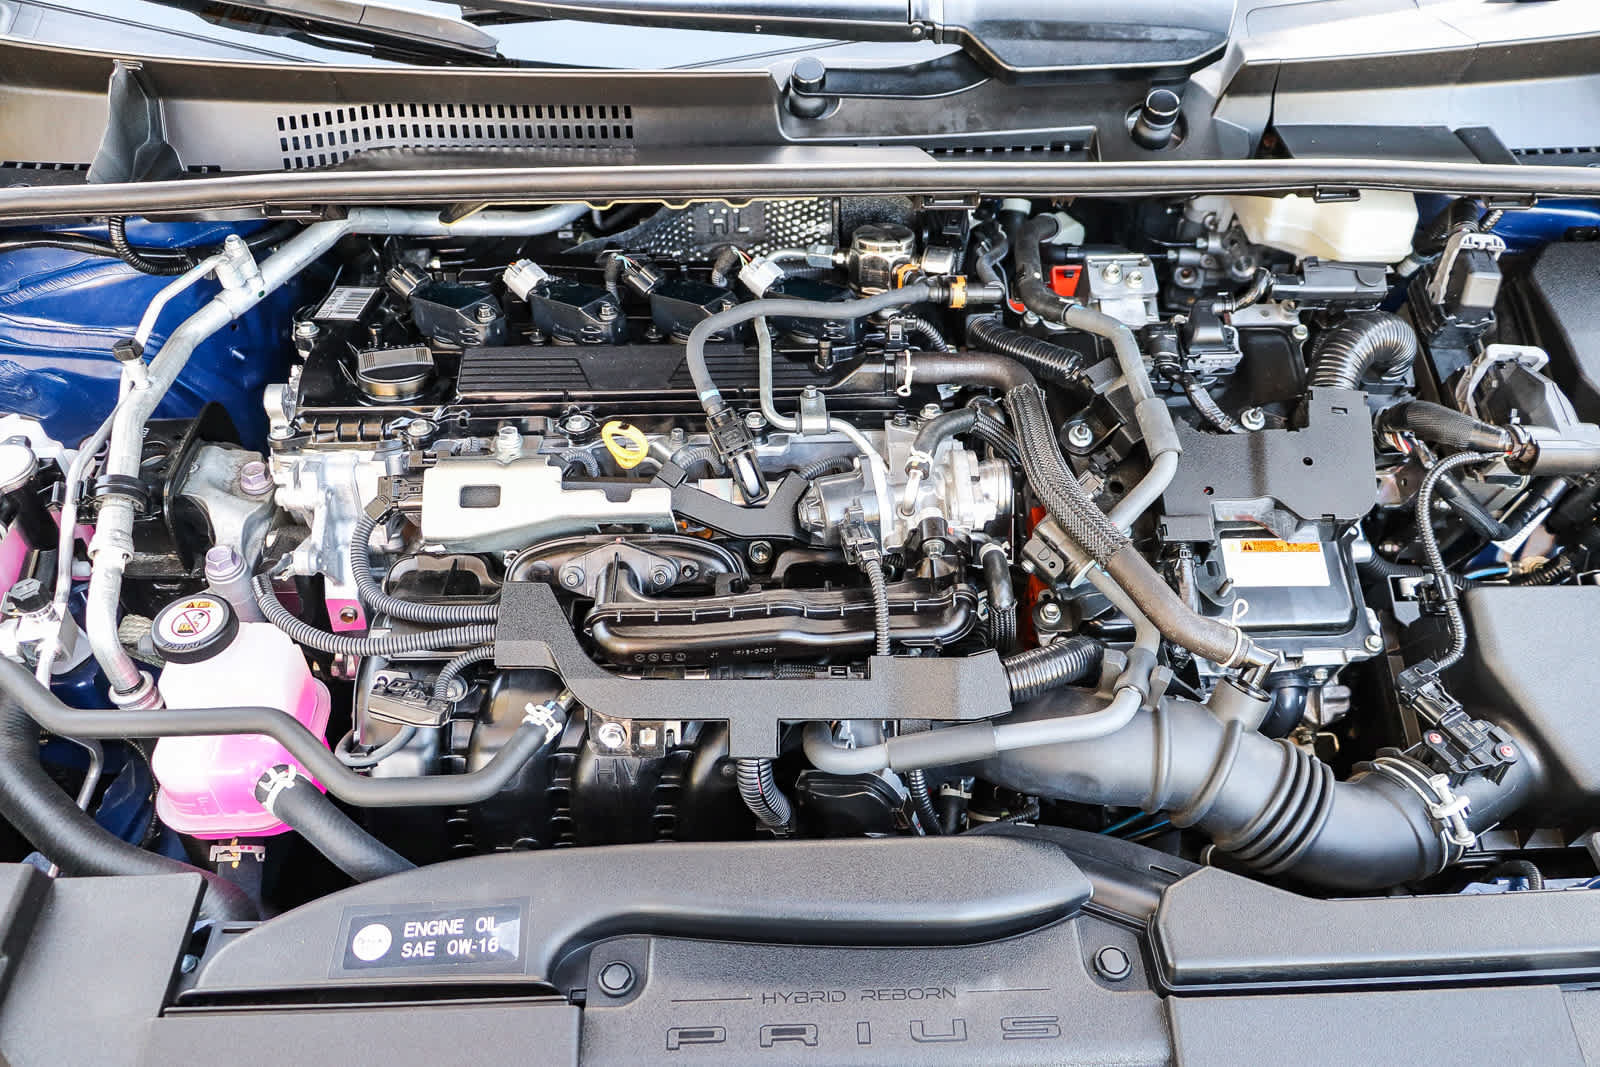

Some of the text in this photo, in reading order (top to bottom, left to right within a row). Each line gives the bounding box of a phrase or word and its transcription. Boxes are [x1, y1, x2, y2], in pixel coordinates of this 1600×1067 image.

[403, 916, 498, 938] ENGINE OIL
[401, 940, 437, 959] SAE
[446, 937, 500, 956] 0W-16
[761, 987, 958, 1005] HYBRID REBORN
[666, 1015, 1062, 1051] PRIUS
